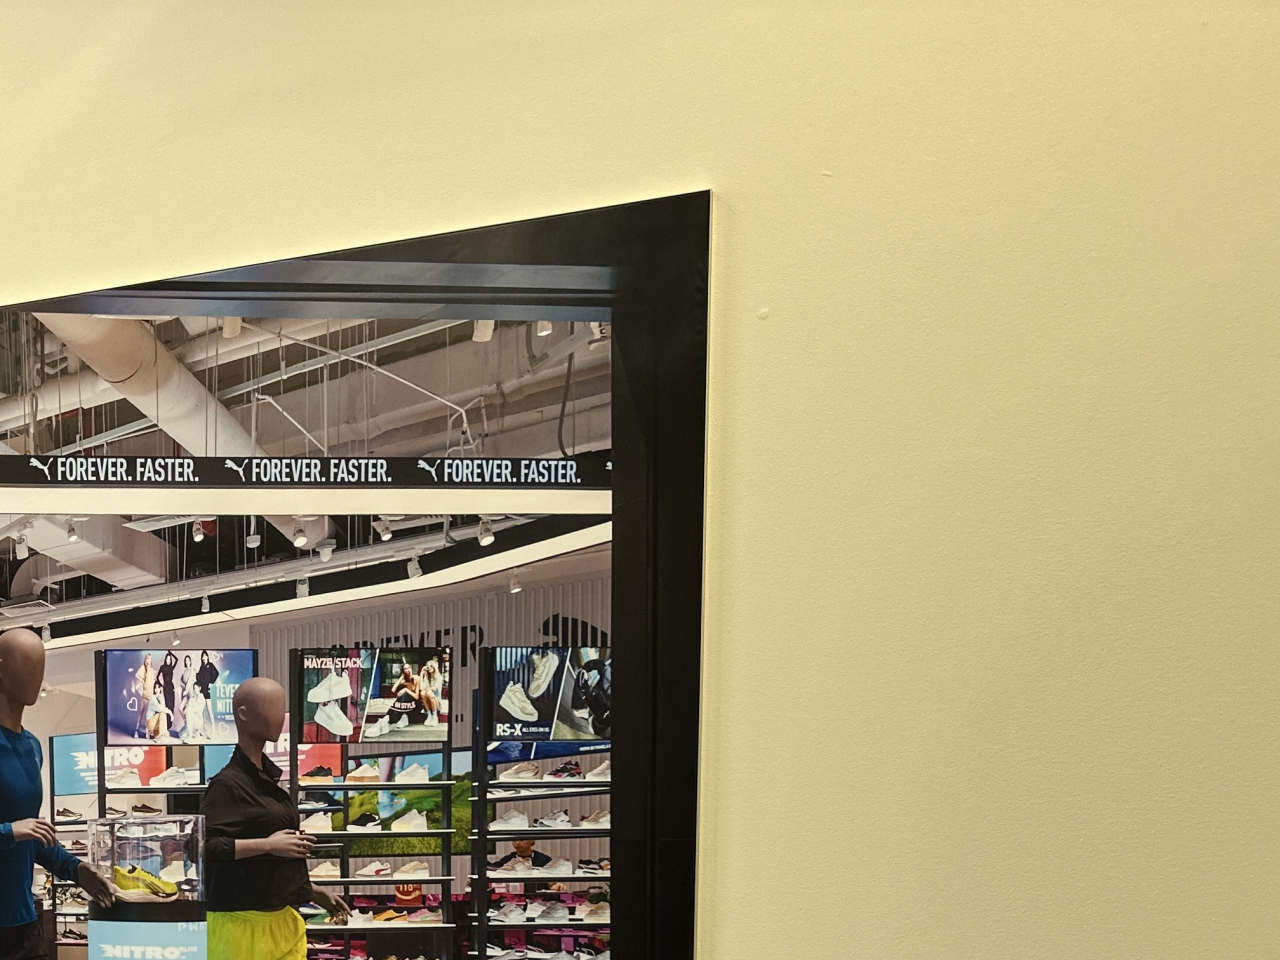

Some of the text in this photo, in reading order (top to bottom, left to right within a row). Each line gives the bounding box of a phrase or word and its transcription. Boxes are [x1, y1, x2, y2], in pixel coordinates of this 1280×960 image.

[57, 458, 199, 482] FOREVER. FASTER.
[251, 459, 392, 482] FOREVER. FASTER.
[444, 459, 581, 483] FOREVER. FASTER.
[304, 657, 363, 669] MAYZE STACK
[496, 723, 522, 736] RS-X
[70, 746, 145, 769] NTRO
[99, 944, 181, 960] NITRO
